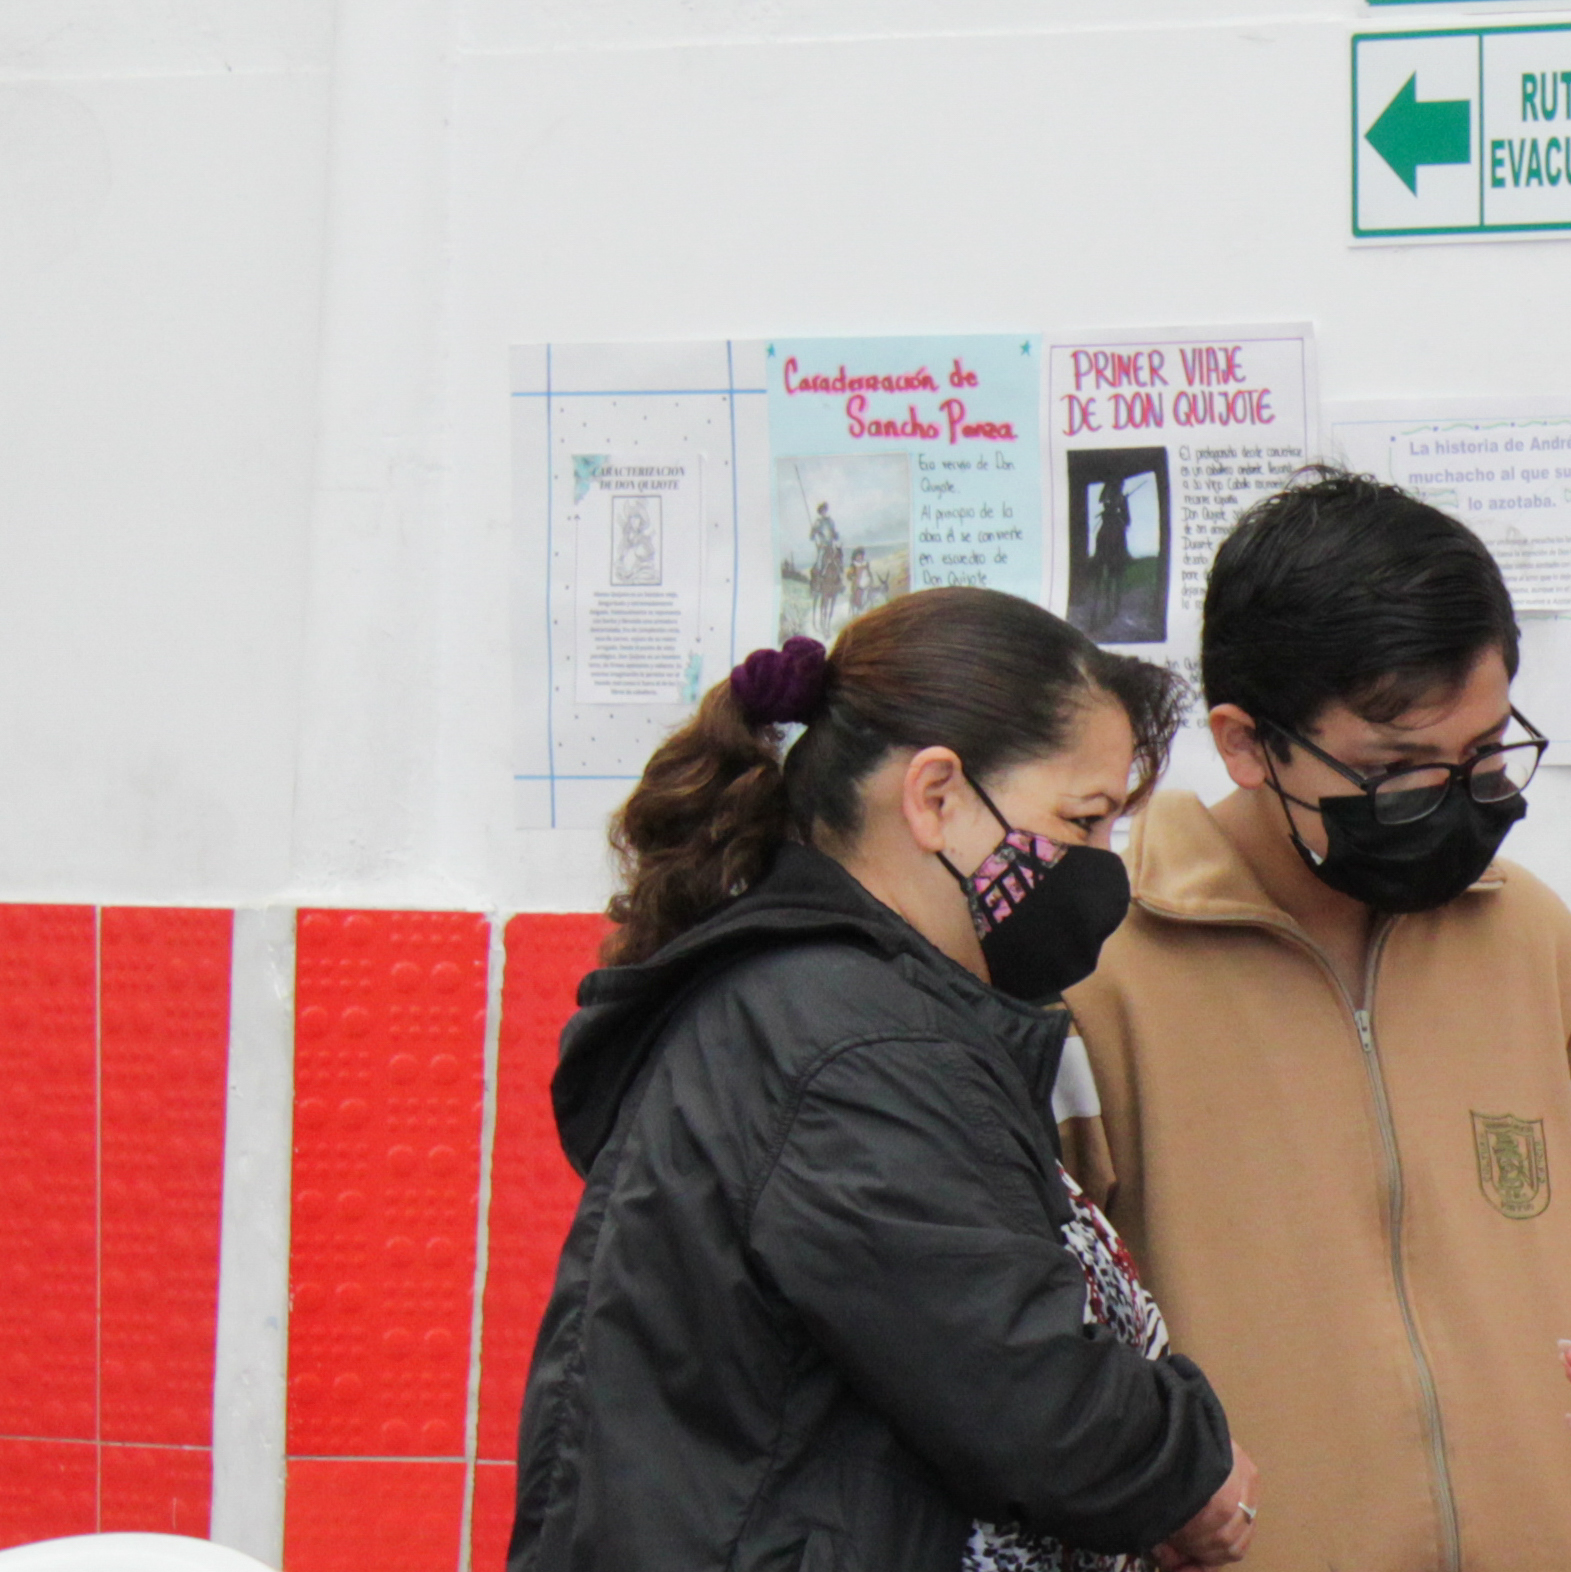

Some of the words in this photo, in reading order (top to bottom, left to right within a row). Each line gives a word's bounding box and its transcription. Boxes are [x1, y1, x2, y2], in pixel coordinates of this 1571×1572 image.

[949, 357, 979, 388] de
[1179, 346, 1246, 387] VIAJE
[845, 394, 940, 439] Sancho
[1060, 394, 1103, 437] DE
[1107, 391, 1164, 431] DON
[1173, 388, 1276, 428] QUIJOTE
[1409, 441, 1429, 456] La
[1435, 438, 1499, 455] historia
[1504, 435, 1525, 453] de
[976, 455, 988, 470] de
[996, 450, 1015, 470] Don
[1408, 466, 1495, 484] muchacho
[1500, 465, 1515, 481] al
[1520, 466, 1550, 485] que
[980, 502, 993, 518] de
[1002, 501, 1013, 518] la
[1468, 494, 1483, 511] lo
[1488, 492, 1557, 510] azotaba.
[994, 547, 1008, 564] de
[923, 569, 942, 585] Don
